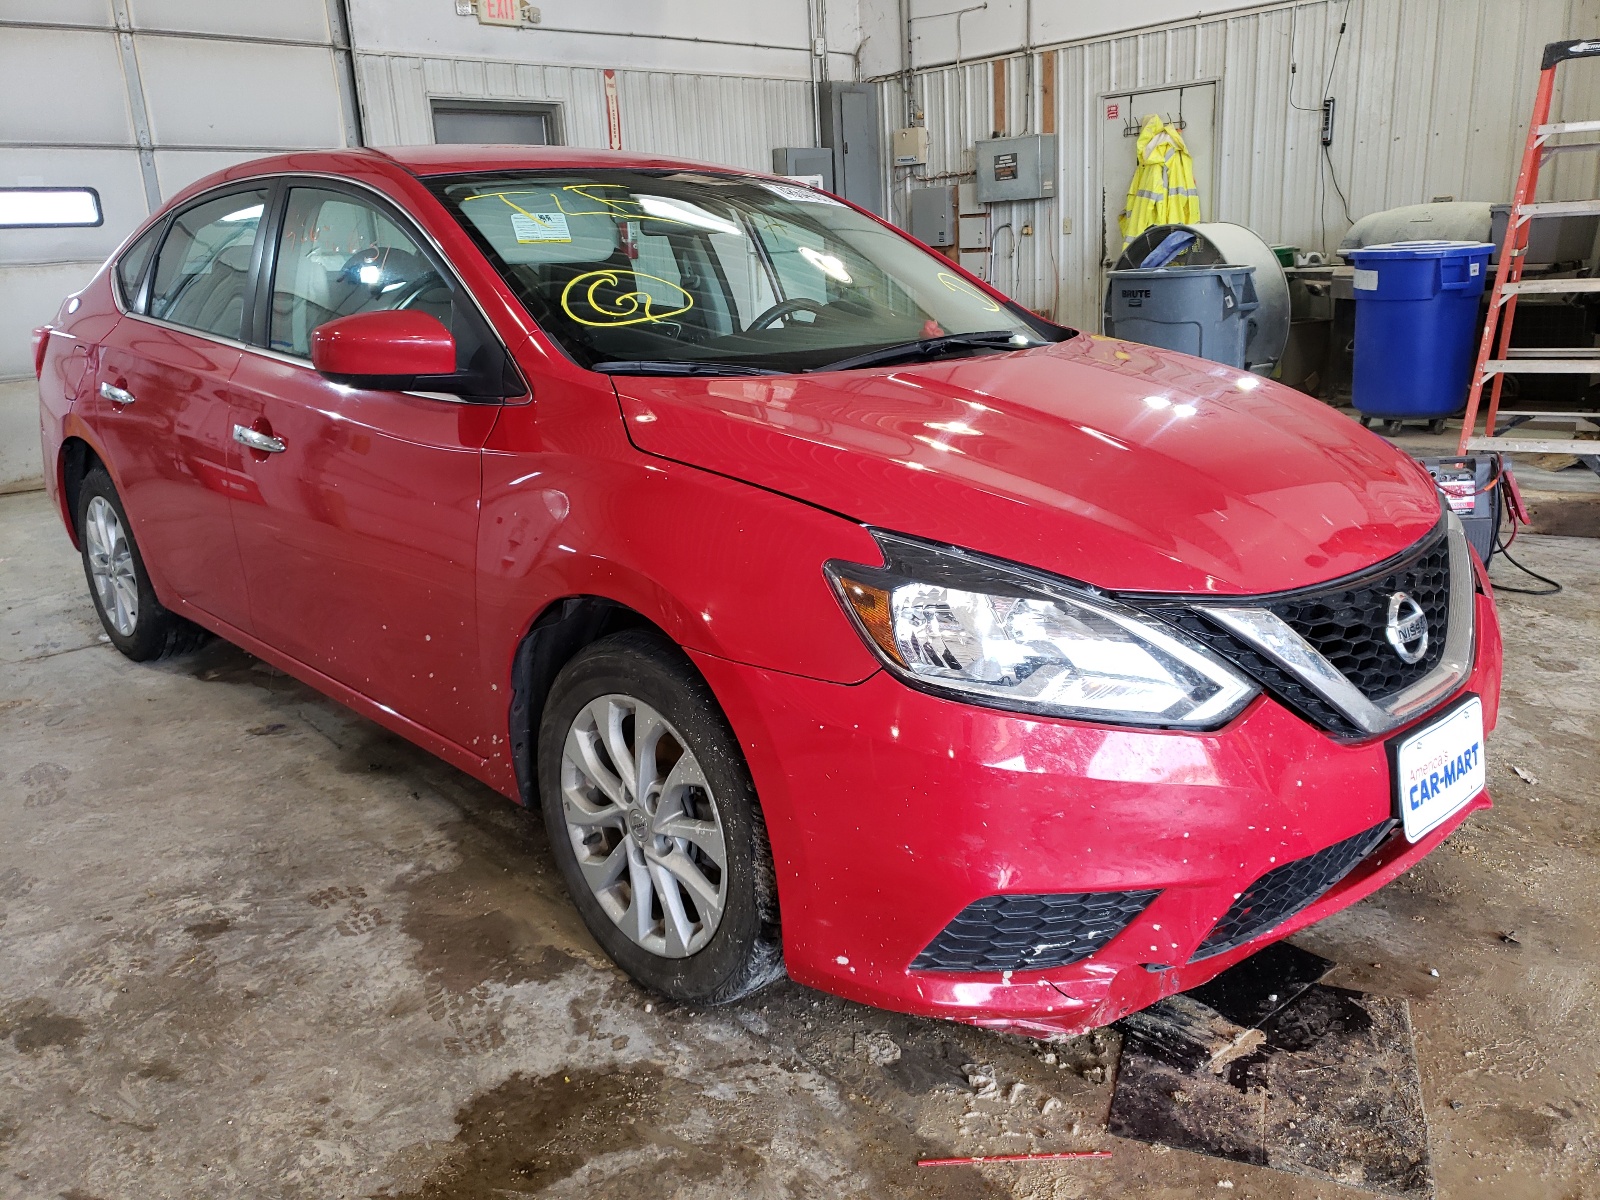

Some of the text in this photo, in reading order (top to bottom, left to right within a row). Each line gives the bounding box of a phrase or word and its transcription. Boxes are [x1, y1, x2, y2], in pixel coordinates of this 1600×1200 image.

[487, 0, 515, 20] EXIT
[1121, 289, 1151, 298] BRUTE
[1397, 614, 1427, 640] NISS
[1409, 741, 1479, 811] CAR-MART
